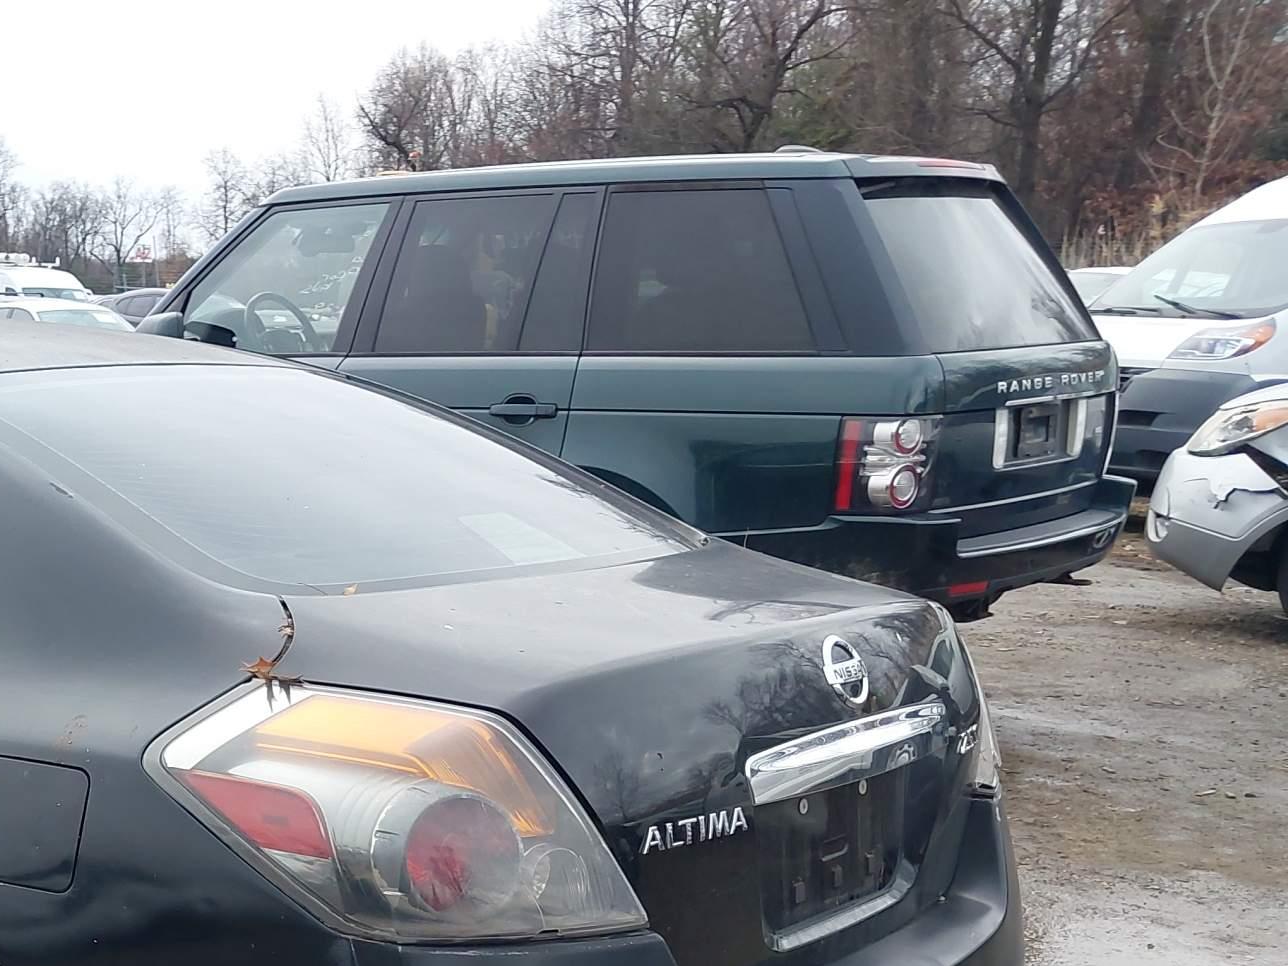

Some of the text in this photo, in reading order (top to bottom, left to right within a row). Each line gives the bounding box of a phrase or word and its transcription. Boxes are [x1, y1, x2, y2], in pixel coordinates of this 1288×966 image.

[997, 369, 1105, 394] RANGE ROVER
[641, 806, 749, 855] ALTIMA
